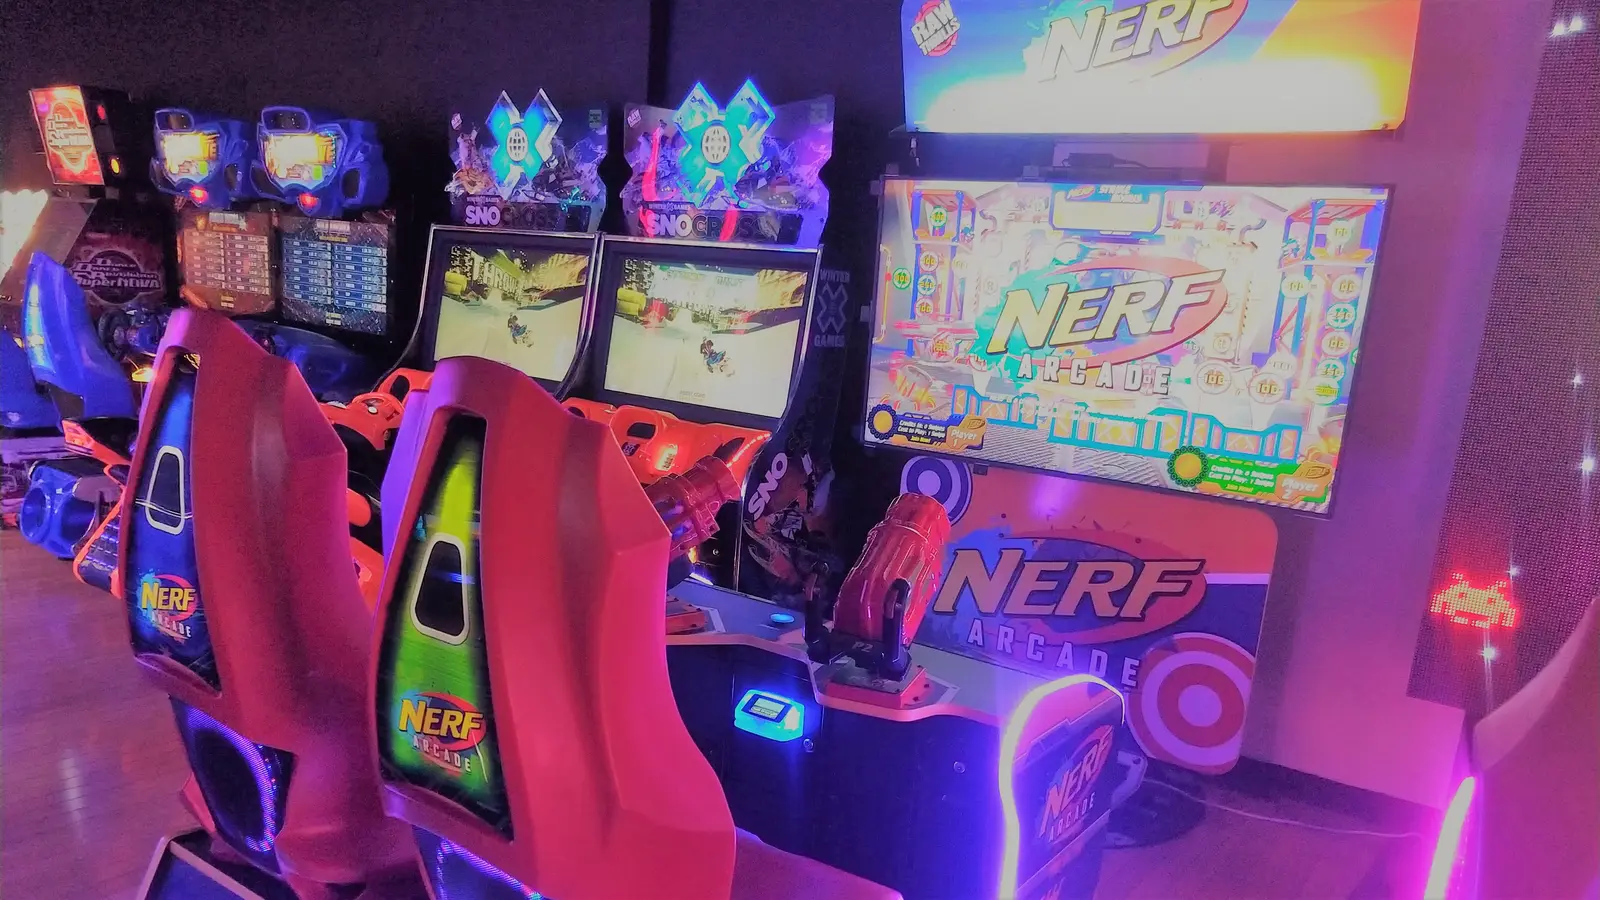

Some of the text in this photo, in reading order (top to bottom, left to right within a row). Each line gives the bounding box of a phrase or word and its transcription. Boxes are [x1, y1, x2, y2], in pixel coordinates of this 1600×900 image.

[911, 0, 954, 46] RAW
[1037, 0, 1238, 84] NERF
[819, 268, 850, 284] WINTER
[986, 268, 1227, 356] NERF
[813, 334, 846, 348] GAMES
[1016, 353, 1172, 395] ARCADE
[951, 429, 977, 441] Player
[953, 439, 958, 447] 1
[748, 452, 788, 521] SNO
[1281, 476, 1319, 493] Player
[1283, 489, 1292, 499] 2
[141, 581, 197, 612] NERF
[932, 547, 1207, 622] NERF
[151, 609, 192, 638] ARCADE
[851, 641, 874, 653] P2
[966, 617, 1140, 688] ARCADE
[398, 698, 484, 741] NERF
[412, 734, 472, 773] ARCADE
[1038, 724, 1114, 839] NERF
[1048, 791, 1097, 844] ARCADE
